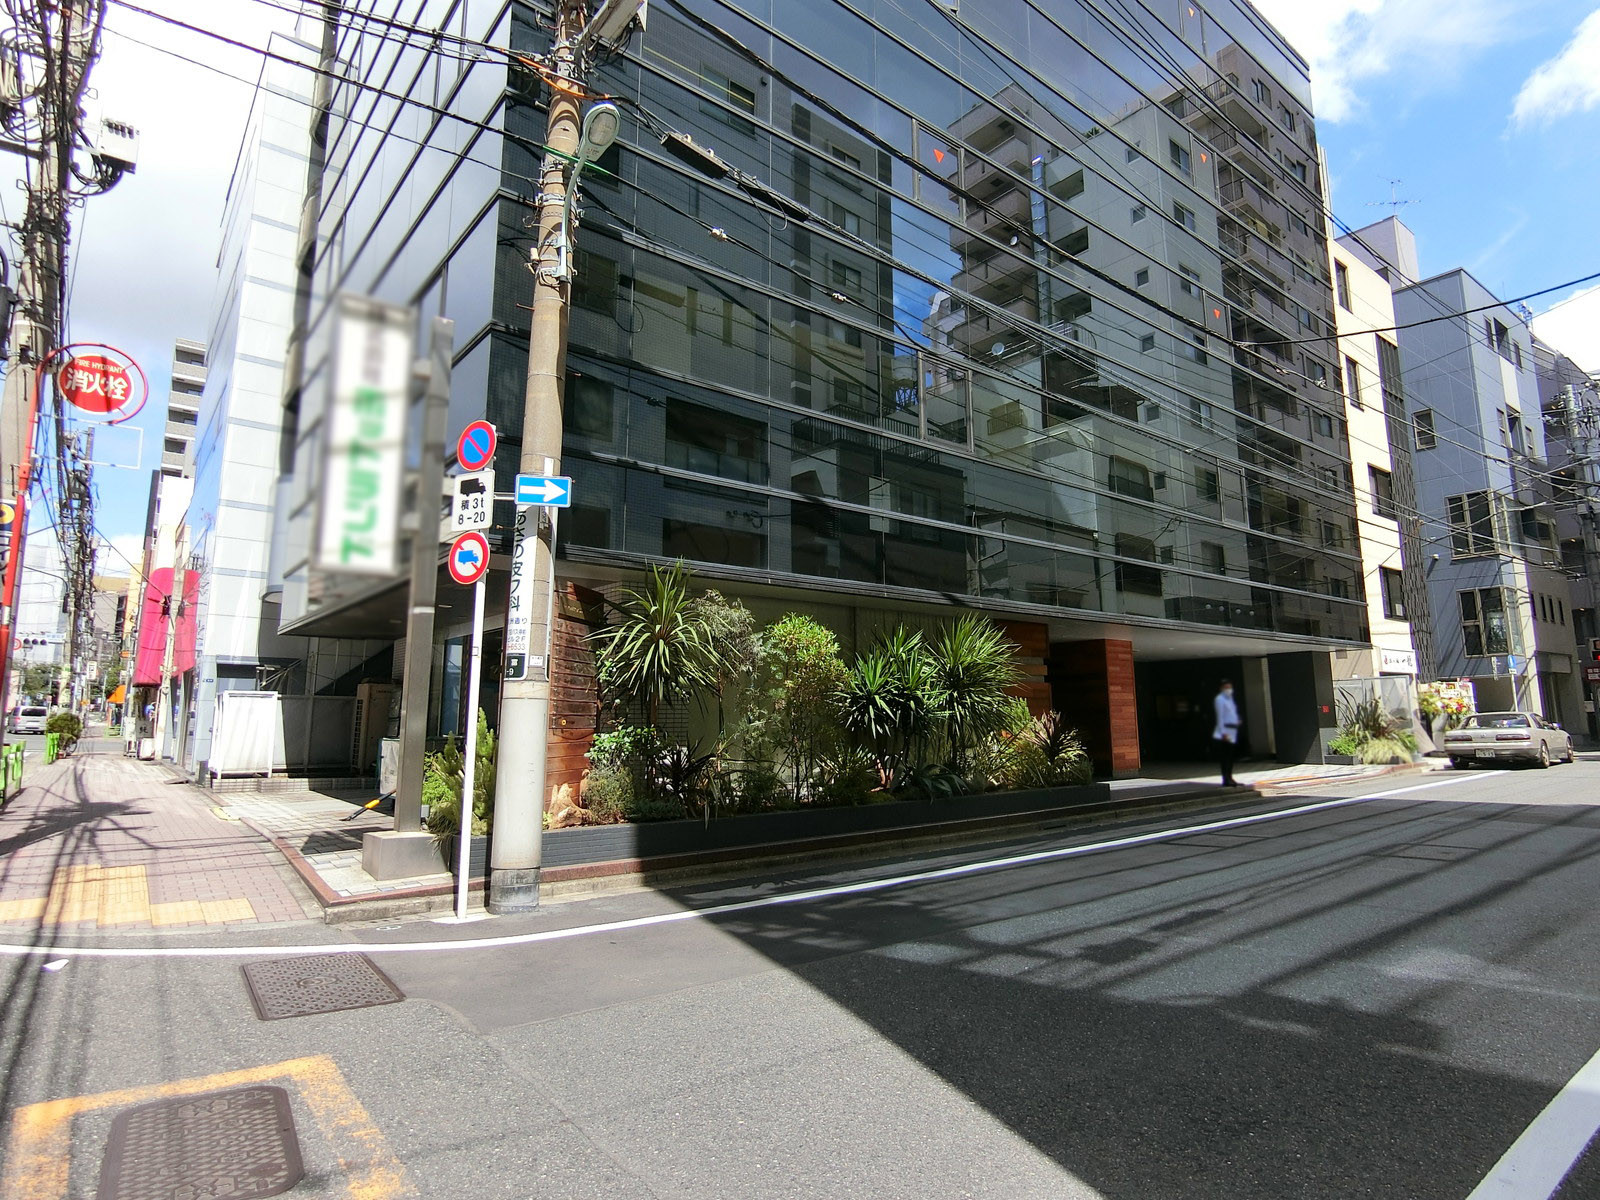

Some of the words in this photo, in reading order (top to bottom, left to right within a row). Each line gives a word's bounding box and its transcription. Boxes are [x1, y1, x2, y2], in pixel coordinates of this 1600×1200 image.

[75, 359, 91, 367] FIRE
[92, 362, 123, 374] HYDRANT
[65, 367, 128, 400] 消火栓
[458, 511, 485, 525] 8-20
